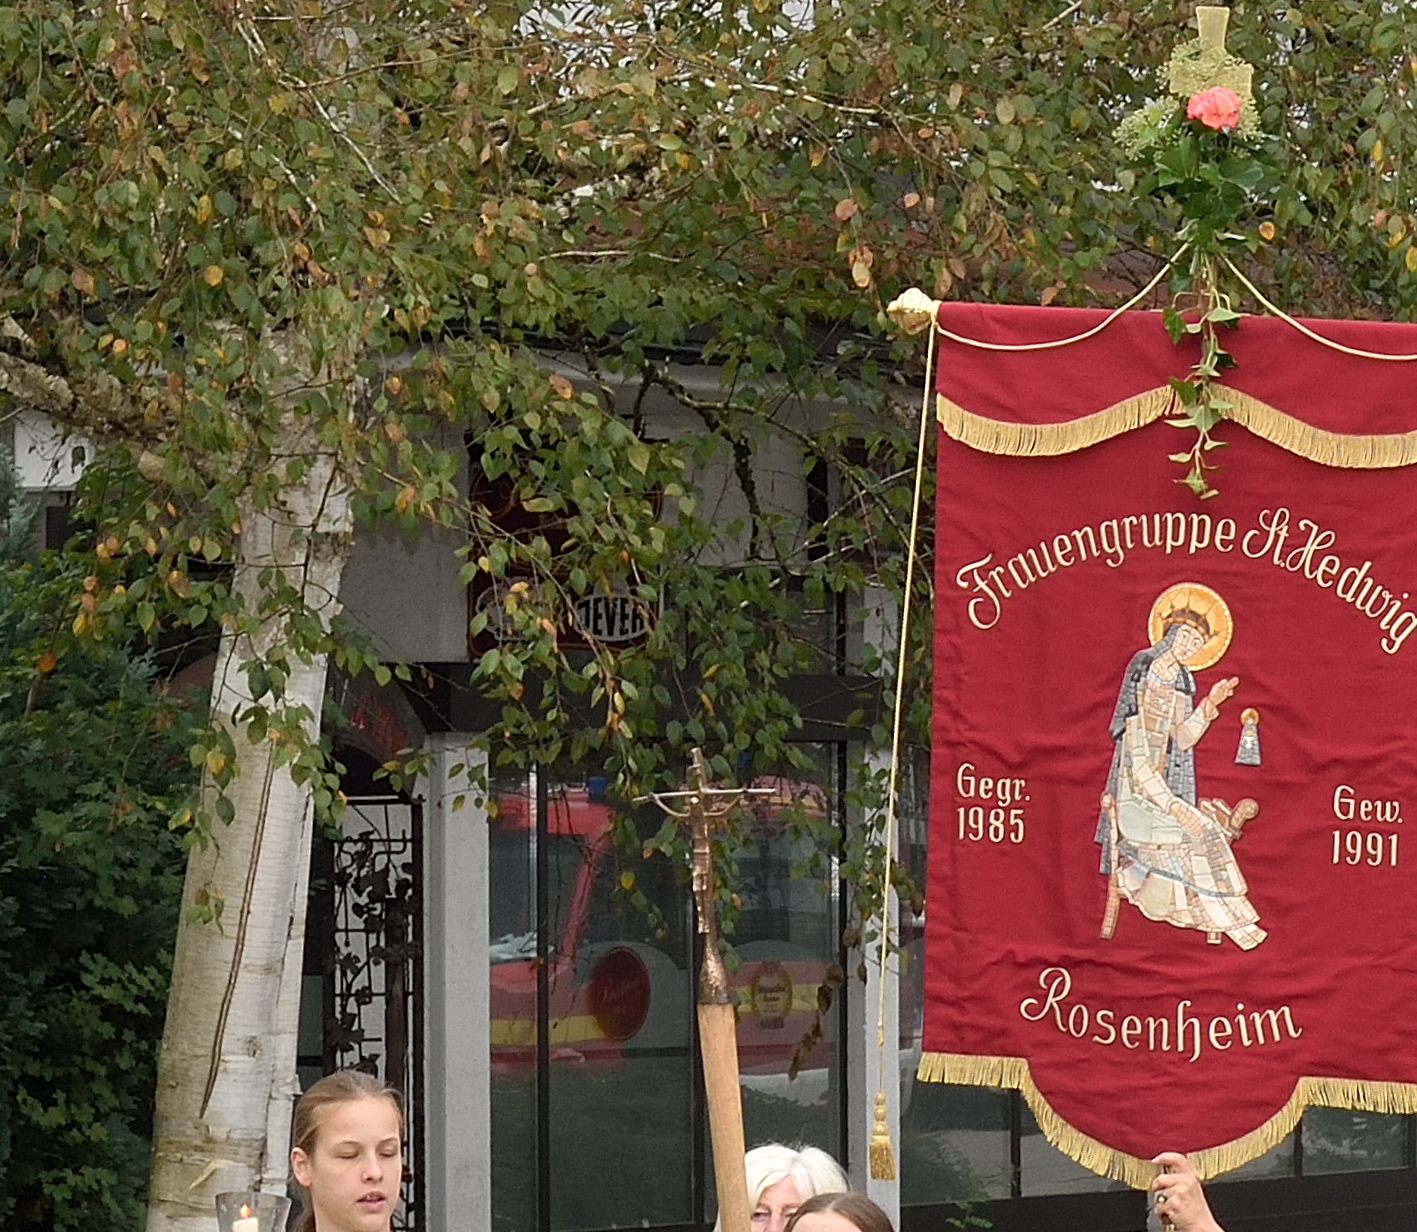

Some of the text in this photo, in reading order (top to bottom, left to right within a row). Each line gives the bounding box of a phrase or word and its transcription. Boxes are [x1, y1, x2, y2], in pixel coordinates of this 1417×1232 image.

[956, 512, 1236, 631] Frauengruppe
[956, 763, 1031, 807] Gegr.
[1332, 784, 1403, 824] Gew.
[956, 806, 1025, 843] 1985
[1332, 830, 1399, 867] 1991
[1020, 967, 1303, 1063] Rosenheim
